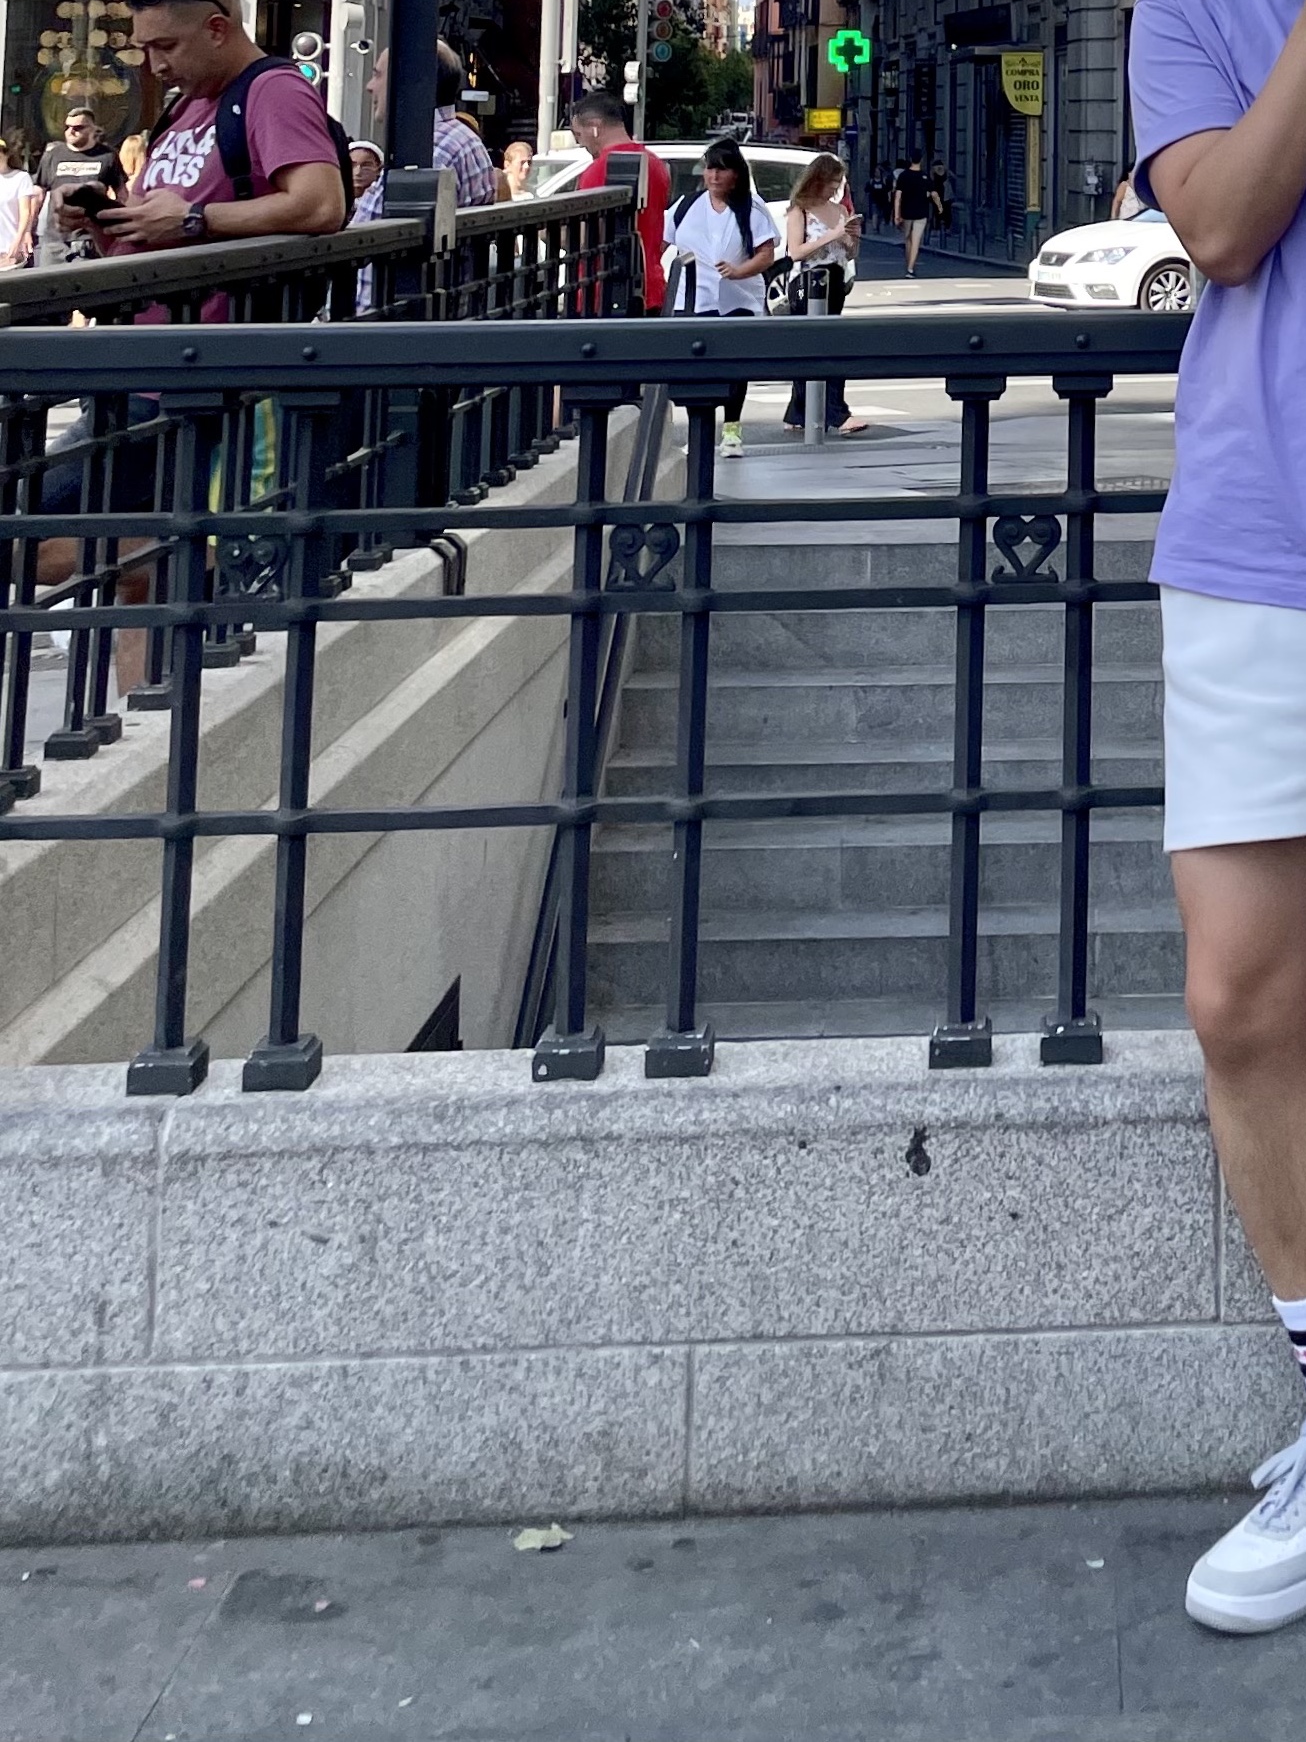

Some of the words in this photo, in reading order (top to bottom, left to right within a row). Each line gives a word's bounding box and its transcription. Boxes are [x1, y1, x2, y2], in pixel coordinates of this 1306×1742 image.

[1005, 68, 1039, 77] COMPRA
[1013, 80, 1039, 91] ORO
[1014, 95, 1039, 103] VENTA
